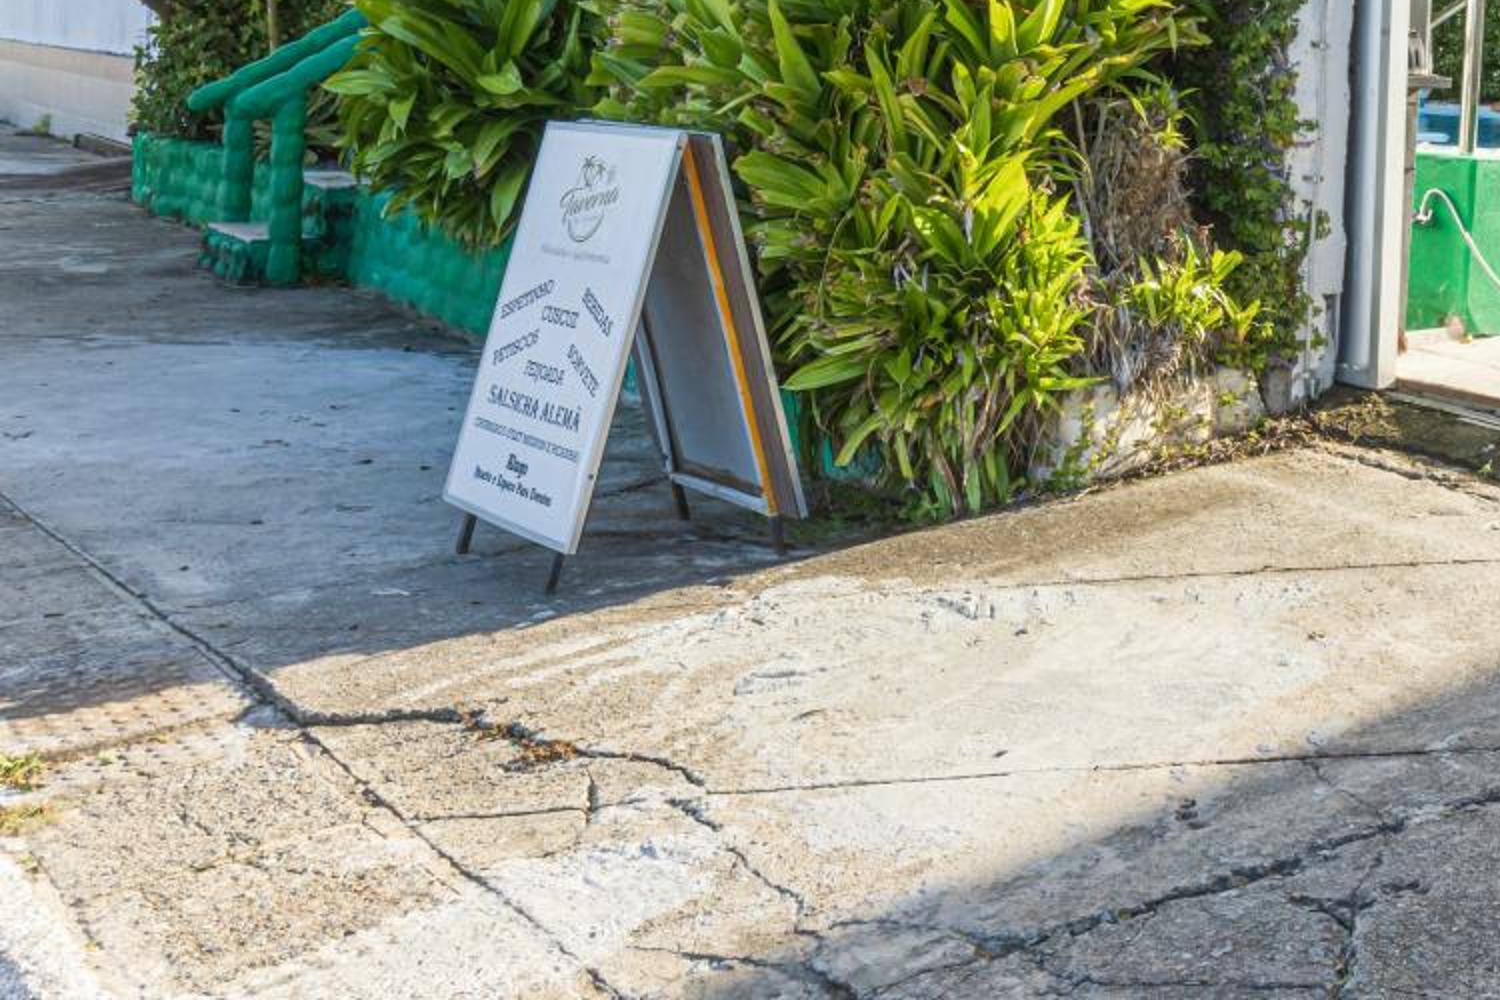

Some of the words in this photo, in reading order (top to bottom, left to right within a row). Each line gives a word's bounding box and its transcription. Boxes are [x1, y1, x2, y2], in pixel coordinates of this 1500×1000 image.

[541, 305, 580, 329] CUSCUZ
[581, 287, 614, 337] BEBIDAS
[493, 328, 540, 366] PETISCOS
[567, 344, 599, 398] SORVETE
[487, 384, 540, 420] SALSICHA
[539, 401, 582, 432] ALEMÃ
